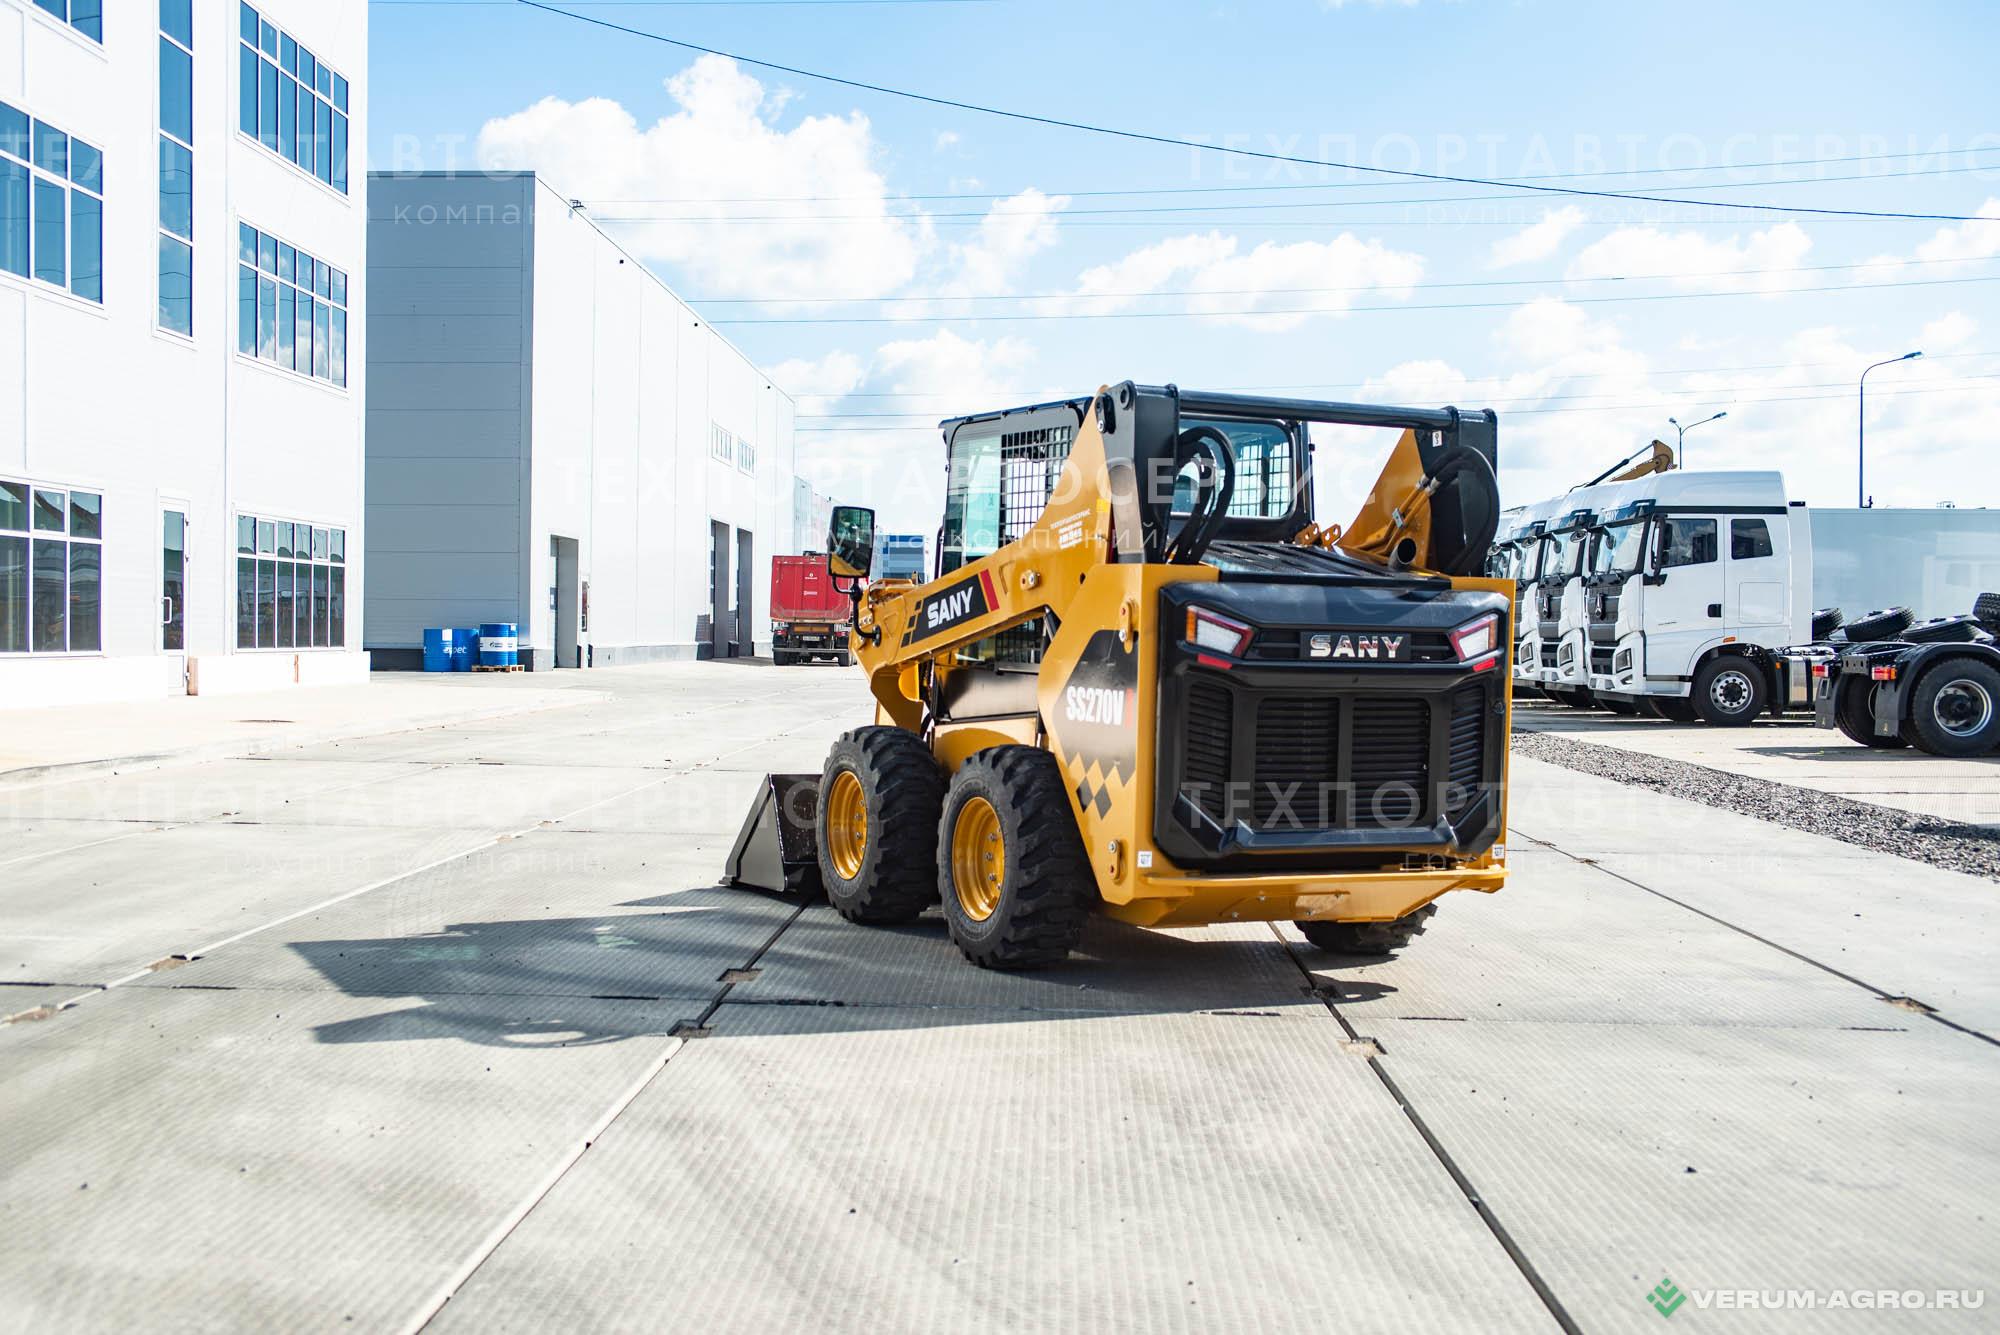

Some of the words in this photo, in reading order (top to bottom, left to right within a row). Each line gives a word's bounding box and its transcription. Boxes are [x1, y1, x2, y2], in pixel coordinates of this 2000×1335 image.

[927, 586, 973, 629] SANY
[1310, 634, 1403, 658] SANY
[1066, 686, 1125, 726] SS270V
